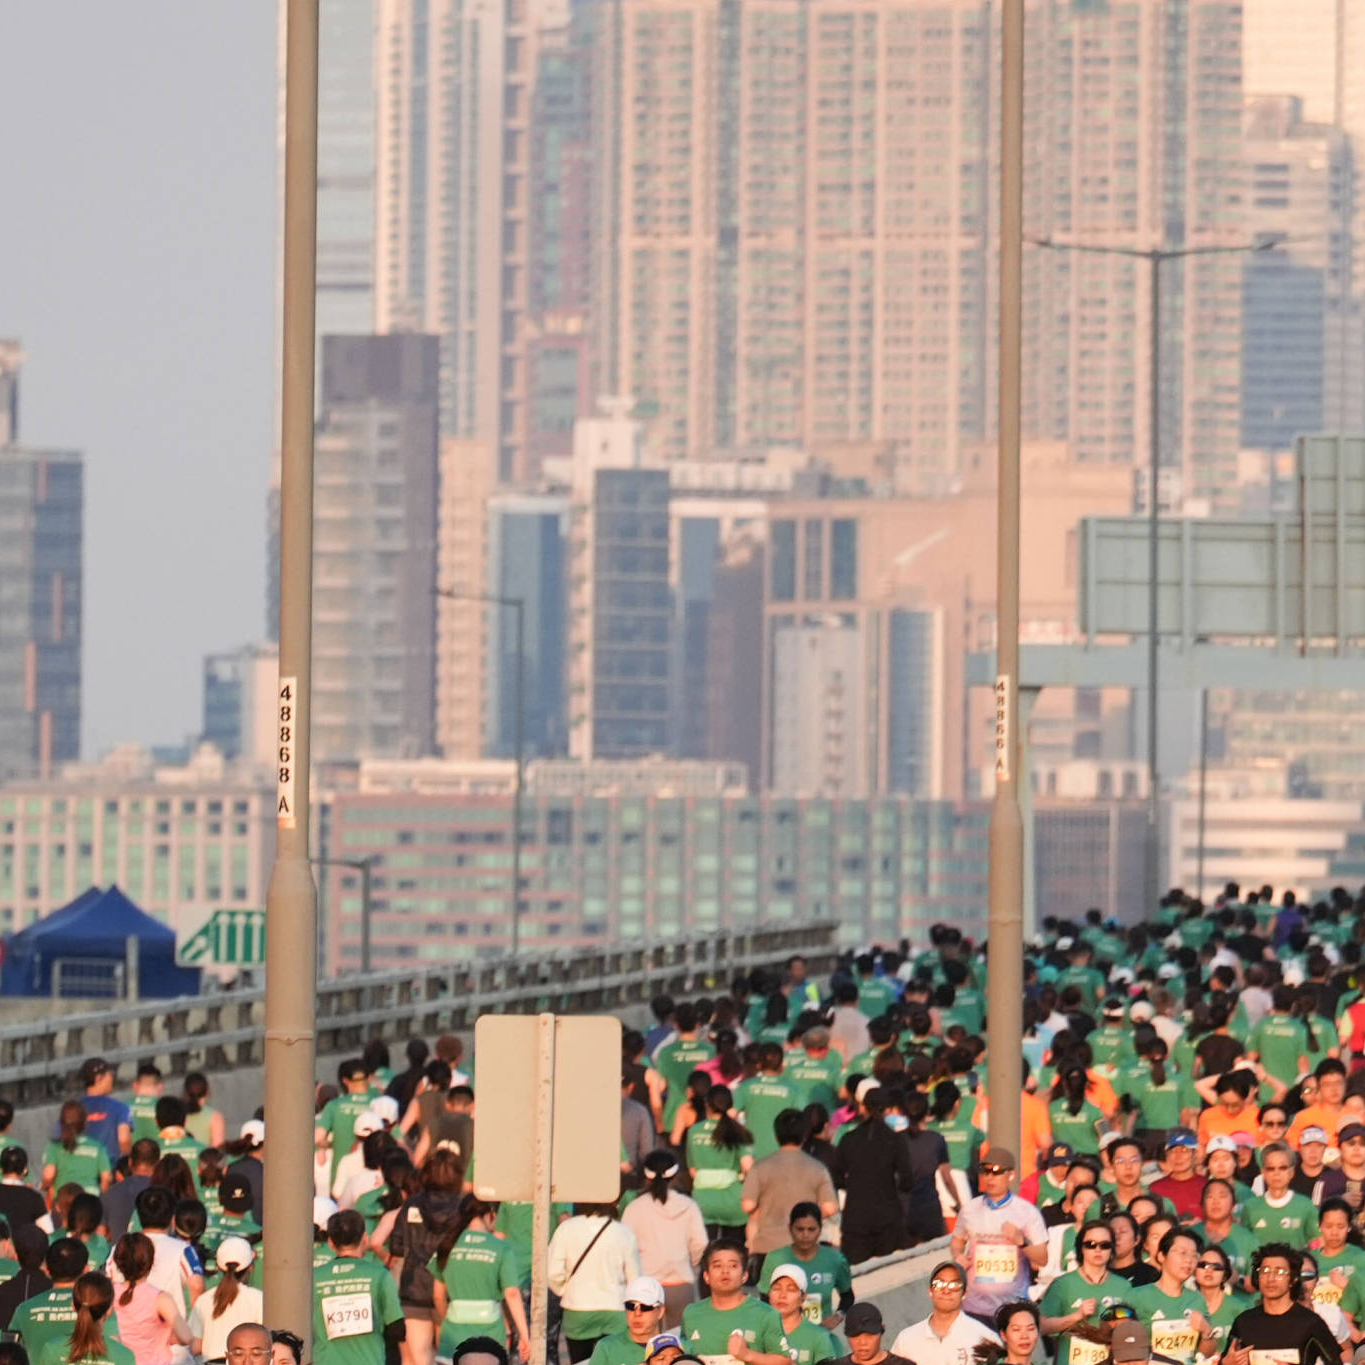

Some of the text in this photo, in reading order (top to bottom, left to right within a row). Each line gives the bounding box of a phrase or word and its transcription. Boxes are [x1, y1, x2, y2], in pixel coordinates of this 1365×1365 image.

[278, 684, 292, 813] 48868 A
[996, 758, 1003, 769] A
[976, 1259, 1015, 1273] P0533
[327, 1309, 369, 1325] K3790
[1155, 1335, 1195, 1350] K2471
